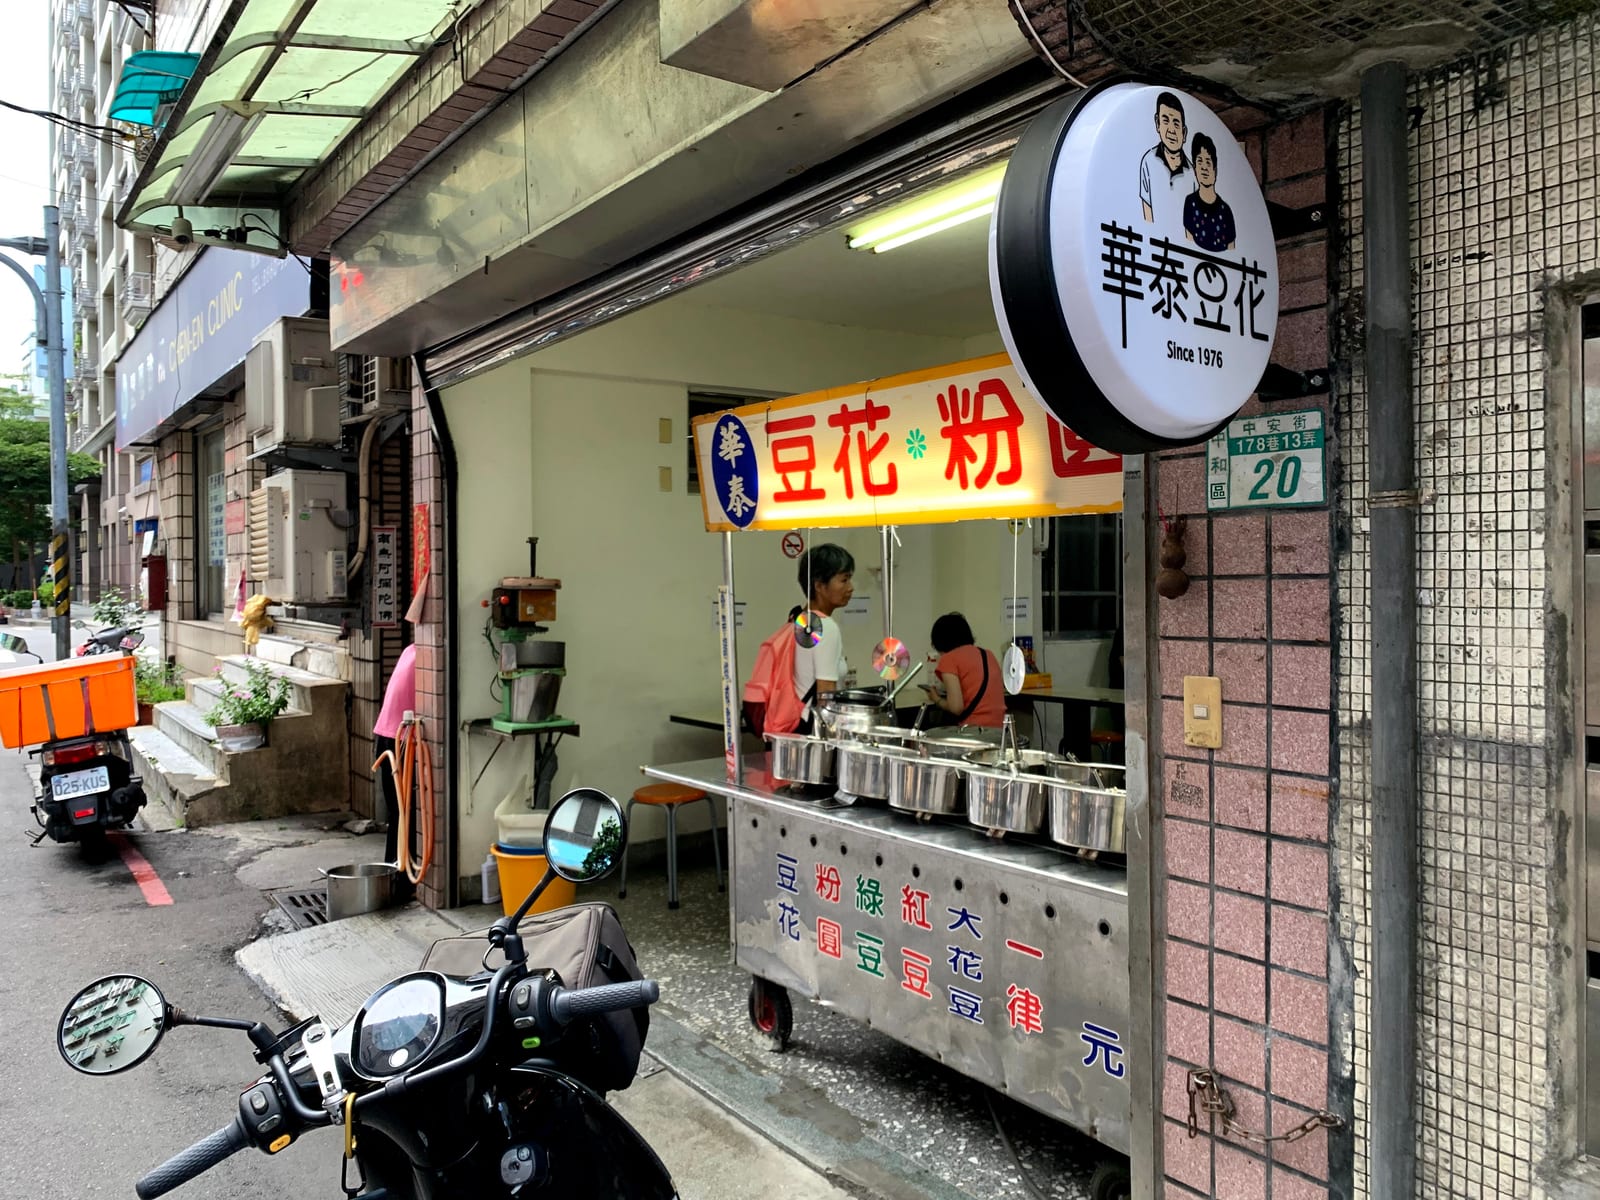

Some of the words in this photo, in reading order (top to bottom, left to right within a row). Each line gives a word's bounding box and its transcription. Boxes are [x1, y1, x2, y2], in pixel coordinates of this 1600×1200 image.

[208, 271, 243, 336] CLINIC
[1101, 220, 1269, 348] 華泰豆花
[1167, 340, 1194, 362] Since
[1198, 346, 1223, 368] 1976
[718, 421, 756, 518] 華泰
[765, 400, 898, 502] 豆花
[1210, 432, 1227, 500] 中和區
[1236, 432, 1316, 453] 178巷13弄
[1242, 415, 1306, 436] 中安街
[1248, 456, 1302, 500] 20
[775, 853, 800, 941] 豆花
[815, 862, 842, 960] 粉圓
[855, 874, 885, 978] 綠豆
[901, 884, 932, 999] 紅豆
[948, 907, 984, 1025] 大花豆
[1006, 939, 1044, 1034] 一律
[1081, 1021, 1125, 1079] 元
